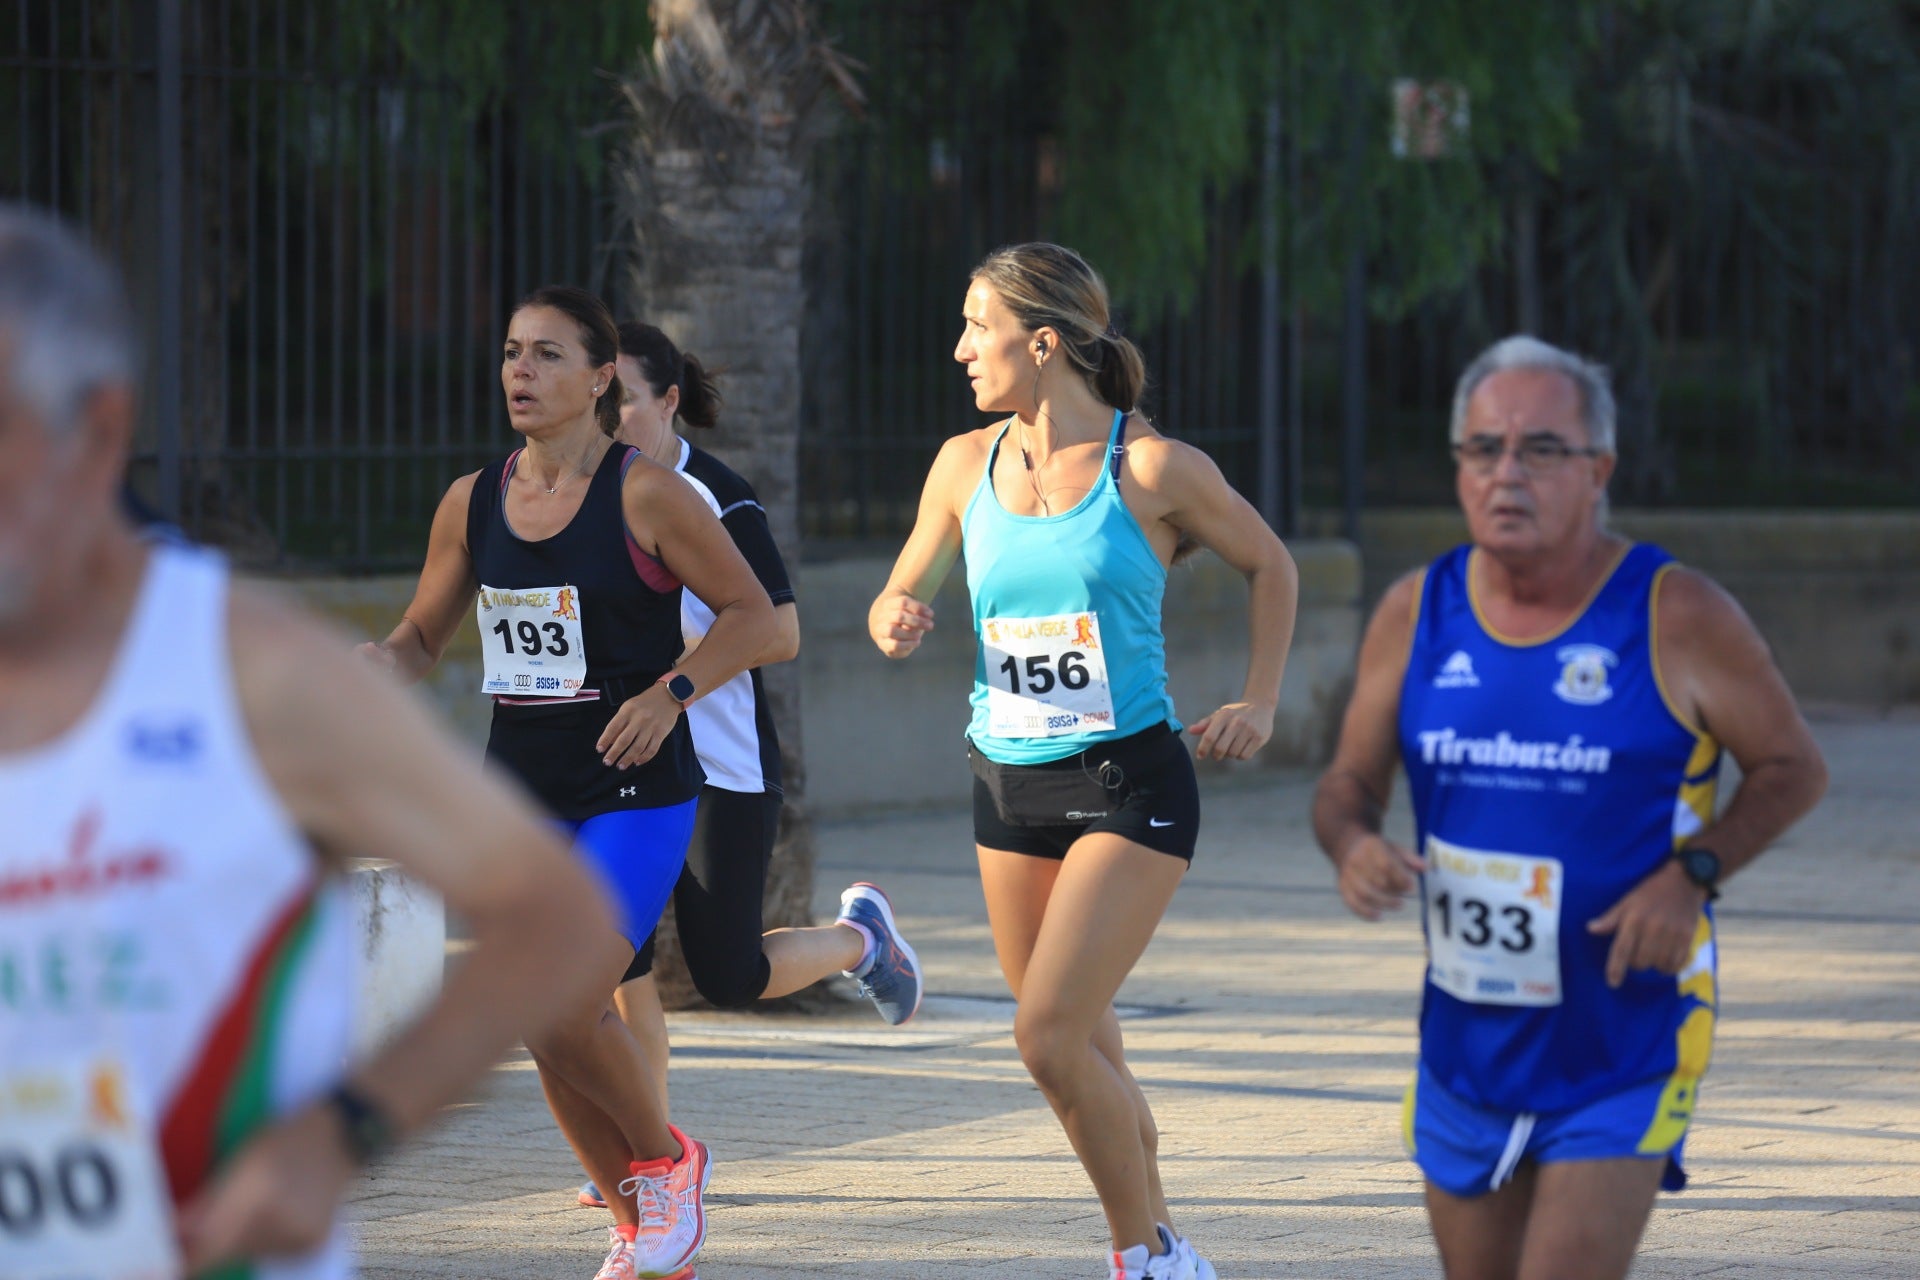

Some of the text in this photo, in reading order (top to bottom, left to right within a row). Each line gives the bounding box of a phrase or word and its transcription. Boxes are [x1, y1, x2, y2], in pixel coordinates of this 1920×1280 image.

[493, 619, 569, 657] 193
[536, 677, 555, 689] asisa
[1000, 651, 1090, 694] 156
[1047, 715, 1072, 729] asisa
[1418, 727, 1611, 773] Tirabuzón
[1435, 889, 1534, 953] 133
